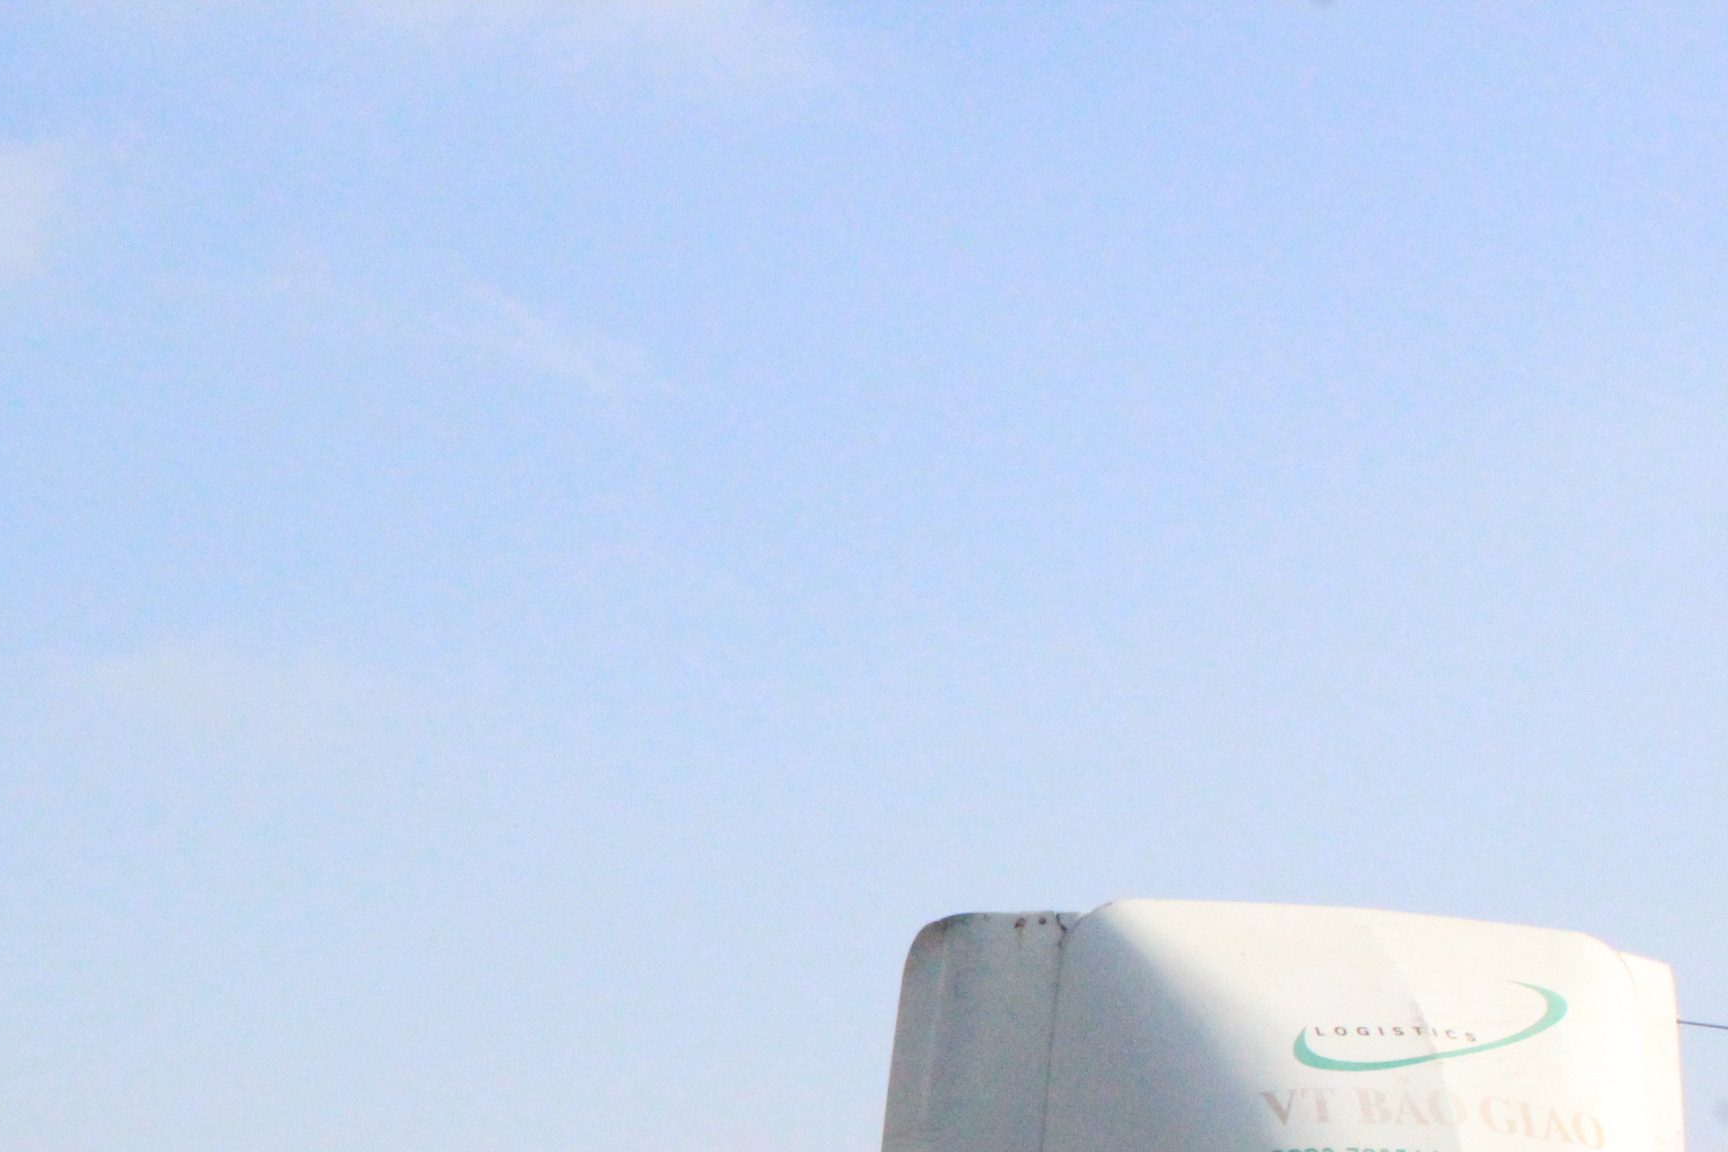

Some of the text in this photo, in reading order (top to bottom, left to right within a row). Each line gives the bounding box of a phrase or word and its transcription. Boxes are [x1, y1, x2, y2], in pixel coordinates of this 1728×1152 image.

[1313, 1026, 1477, 1042] LOGISTICS
[1260, 1086, 1334, 1127] VT
[1478, 1094, 1606, 1151] GIAO
